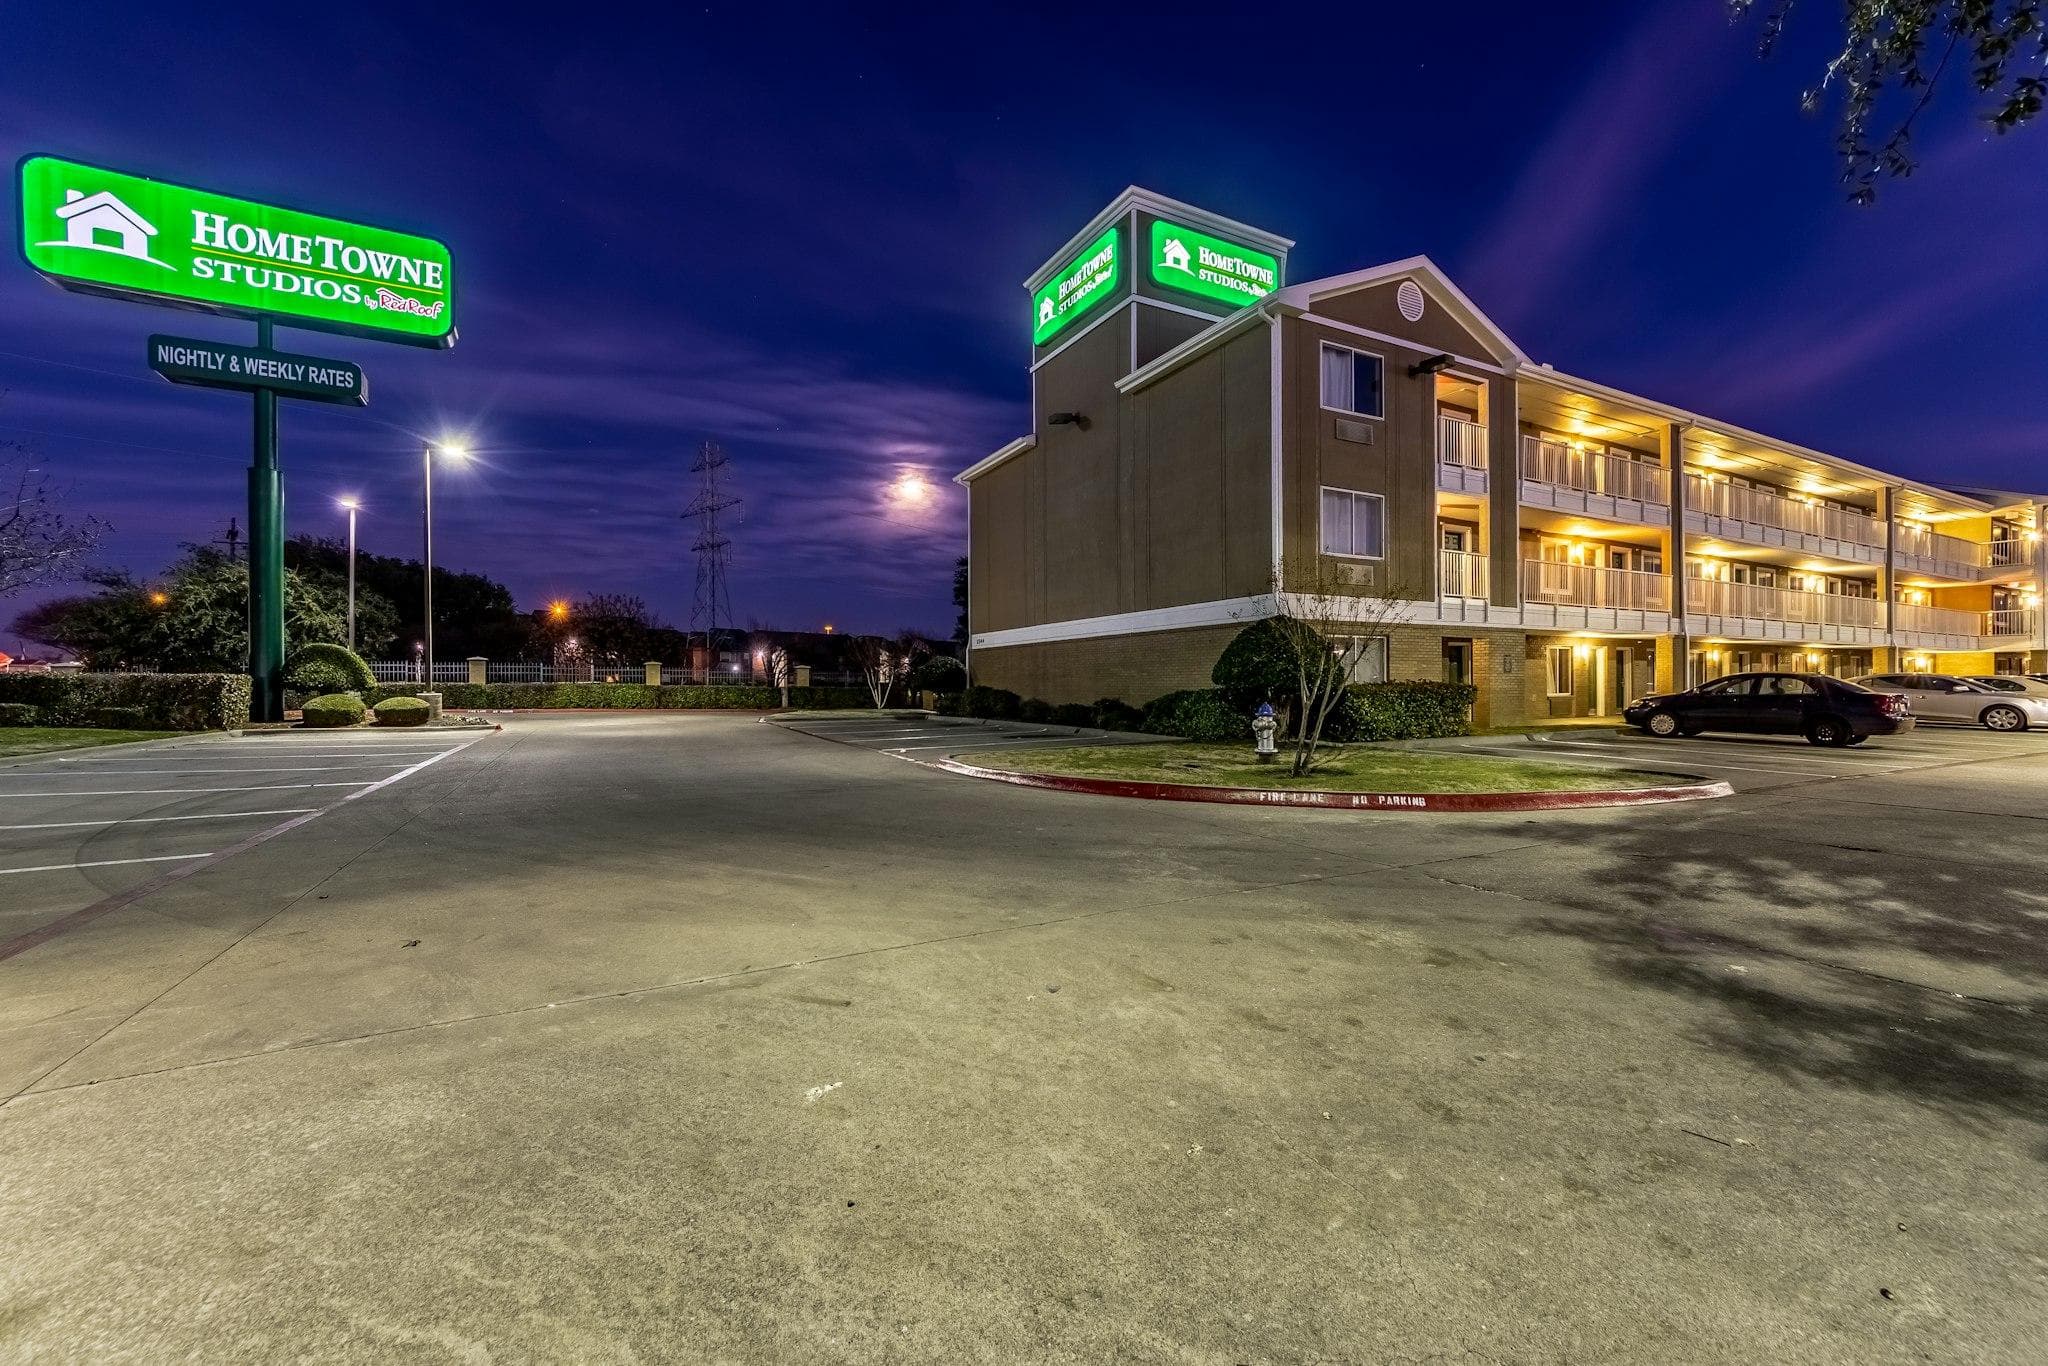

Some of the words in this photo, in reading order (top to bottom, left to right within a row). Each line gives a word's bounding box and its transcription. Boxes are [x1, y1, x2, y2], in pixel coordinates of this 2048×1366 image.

[192, 257, 361, 304] STUDIOS
[1199, 269, 1248, 292] STUDIOS
[364, 295, 378, 310] by
[1059, 280, 1093, 314] STUDIOS
[158, 345, 224, 371] NIGHTLY
[229, 355, 240, 373] &
[244, 357, 304, 381] WEEKLY
[308, 366, 354, 388] RATES
[1259, 792, 1286, 802] FIRE
[1352, 795, 1368, 805] NO
[1379, 796, 1427, 807] PARKING
